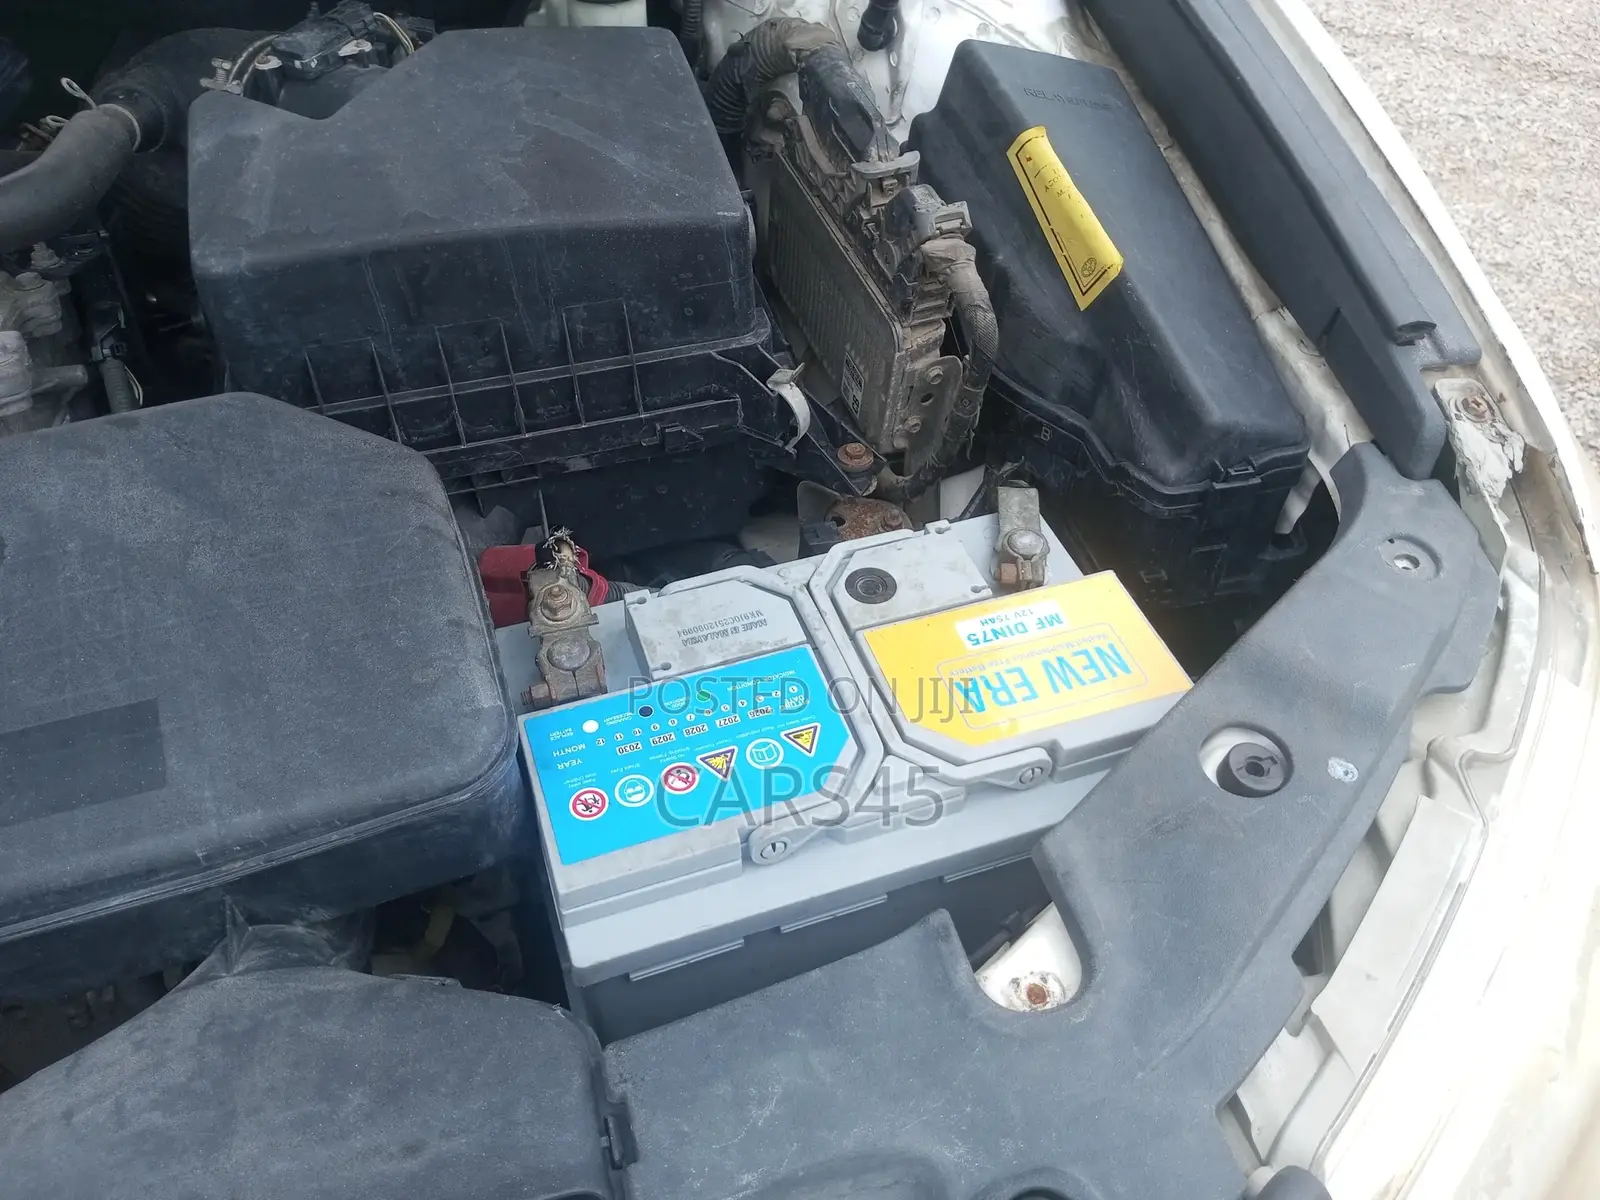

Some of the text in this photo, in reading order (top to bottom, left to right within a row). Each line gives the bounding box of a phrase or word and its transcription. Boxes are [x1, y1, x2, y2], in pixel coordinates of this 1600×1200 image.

[1014, 608, 1034, 619] 12V
[682, 618, 768, 647] MADE IN MALAYSIA
[967, 612, 1064, 646] MF DIN75
[953, 643, 1132, 713] NEW ERA
[718, 715, 739, 727] 2027
[684, 724, 706, 736] 2028
[652, 733, 674, 745] 2029
[553, 743, 586, 757] MONTH
[618, 742, 641, 754] 2030
[557, 758, 583, 769] YEAR
